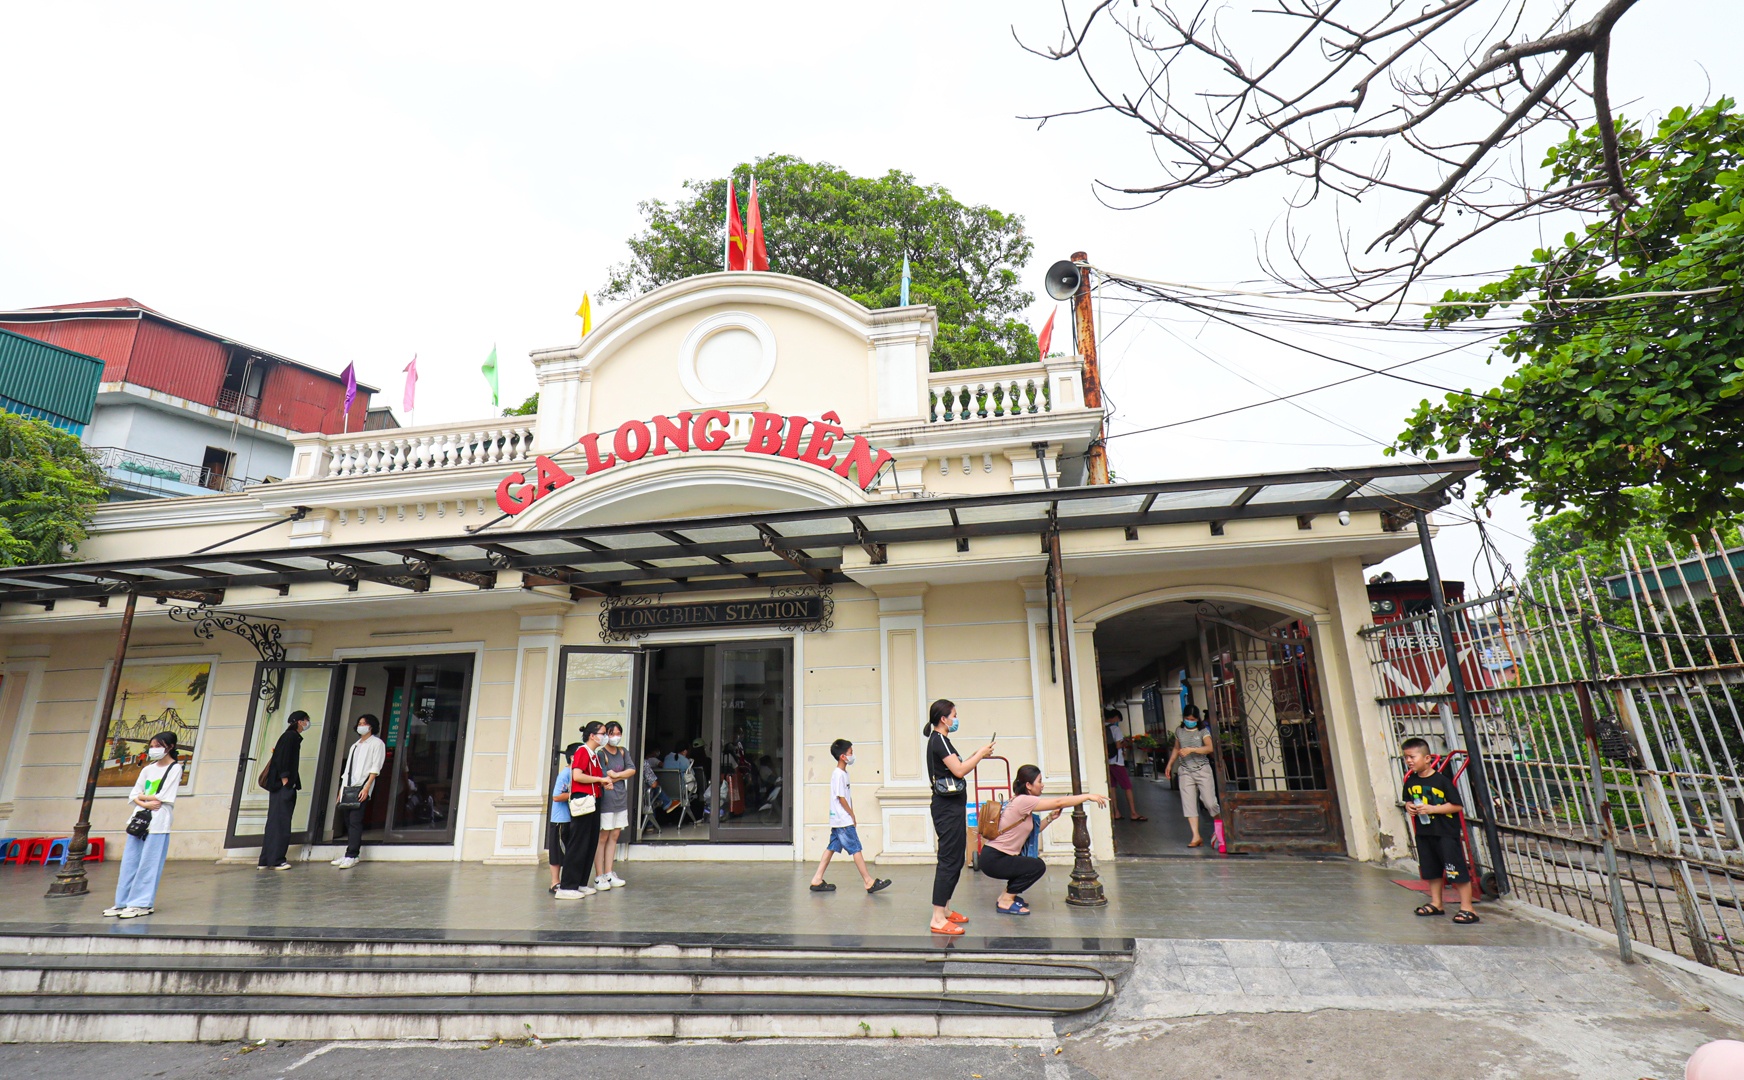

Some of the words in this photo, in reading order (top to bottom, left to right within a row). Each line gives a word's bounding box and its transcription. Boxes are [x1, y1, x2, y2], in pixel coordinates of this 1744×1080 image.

[496, 455, 575, 515] GA
[579, 410, 731, 475] LONG
[744, 410, 893, 490] BIÊN
[619, 605, 718, 627] LONGBIEN
[725, 600, 809, 621] STATION
